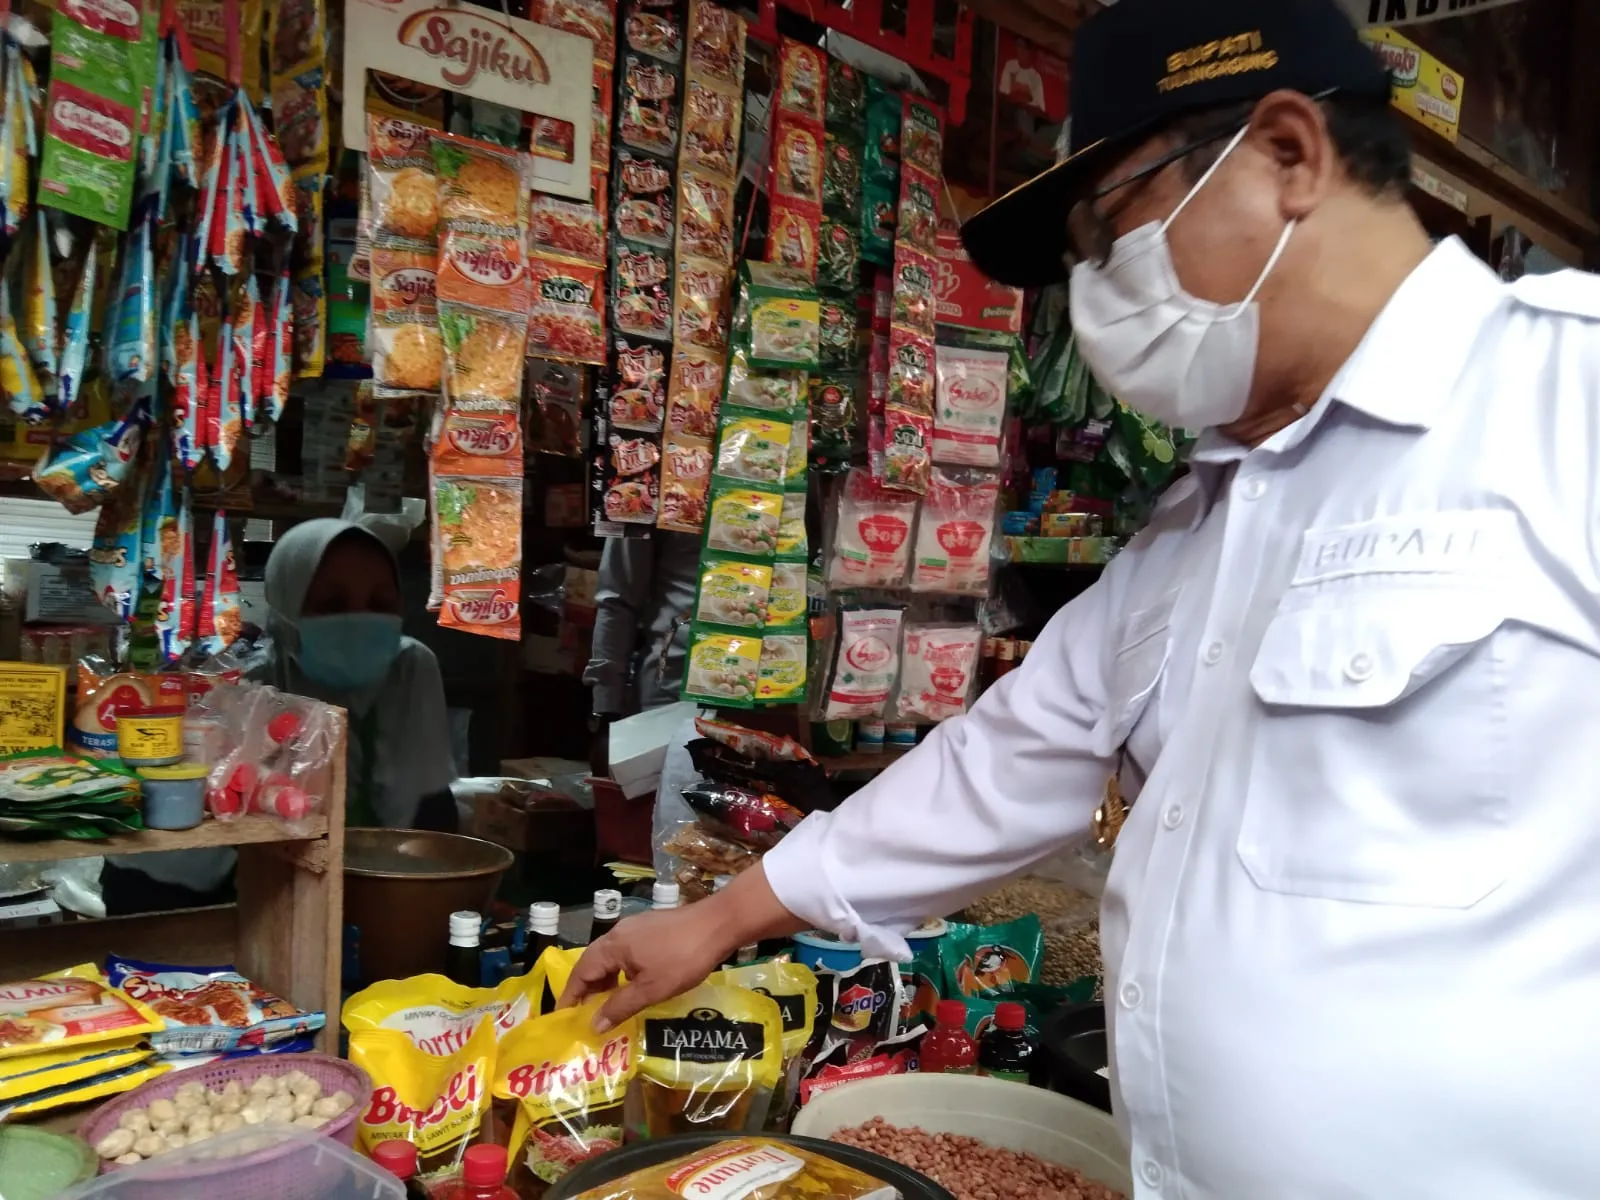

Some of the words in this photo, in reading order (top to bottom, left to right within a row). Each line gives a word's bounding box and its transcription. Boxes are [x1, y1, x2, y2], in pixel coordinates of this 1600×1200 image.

[420, 16, 535, 86] Sajiku
[1167, 30, 1262, 73] BUPATI
[391, 274, 437, 304] Sajik
[457, 421, 514, 450] Sajiku
[460, 589, 514, 620] Sajiku
[662, 1028, 749, 1050] LAPAMA
[691, 1151, 786, 1194] Fortune
